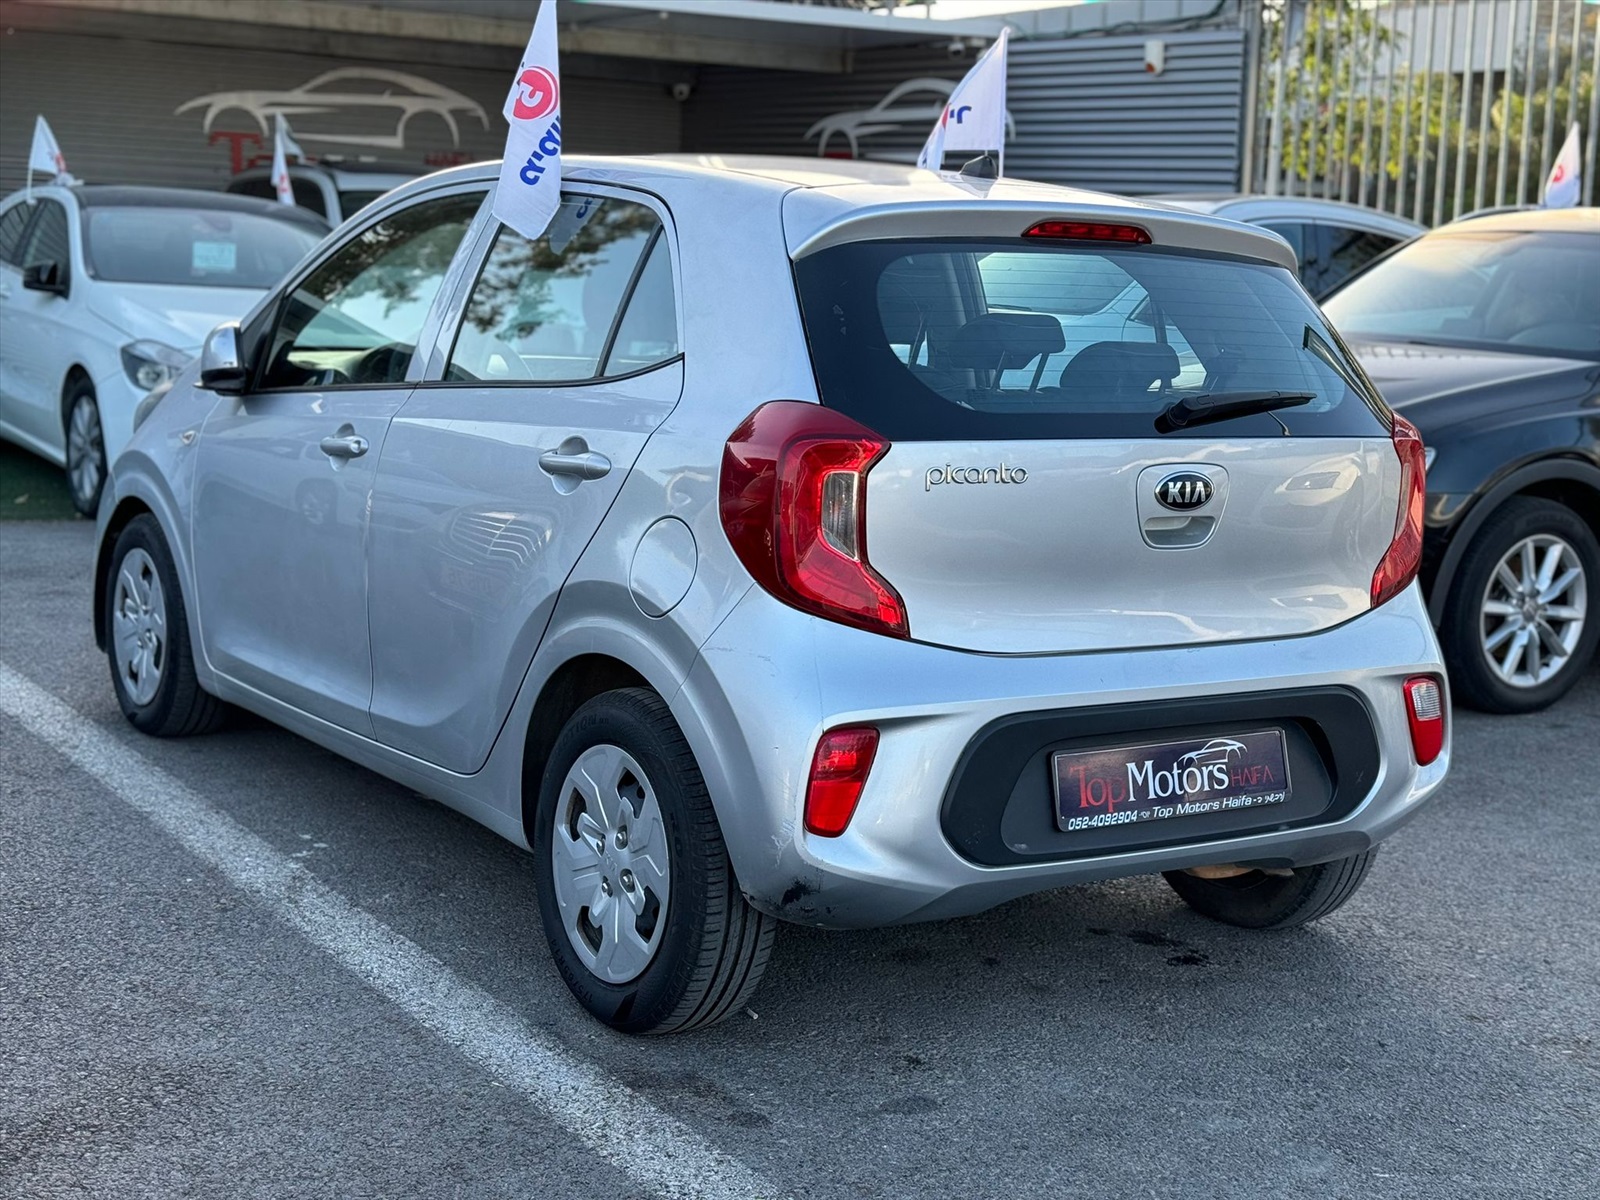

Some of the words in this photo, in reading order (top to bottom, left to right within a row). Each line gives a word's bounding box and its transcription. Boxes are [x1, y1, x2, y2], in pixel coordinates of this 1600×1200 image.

[925, 463, 1028, 491] picanto
[1166, 481, 1207, 503] KIA
[1070, 764, 1126, 812] Top
[1126, 760, 1229, 801] Motors
[1068, 809, 1138, 831] 052-4092904
[1153, 805, 1174, 819] Top
[1176, 800, 1220, 815] Motors
